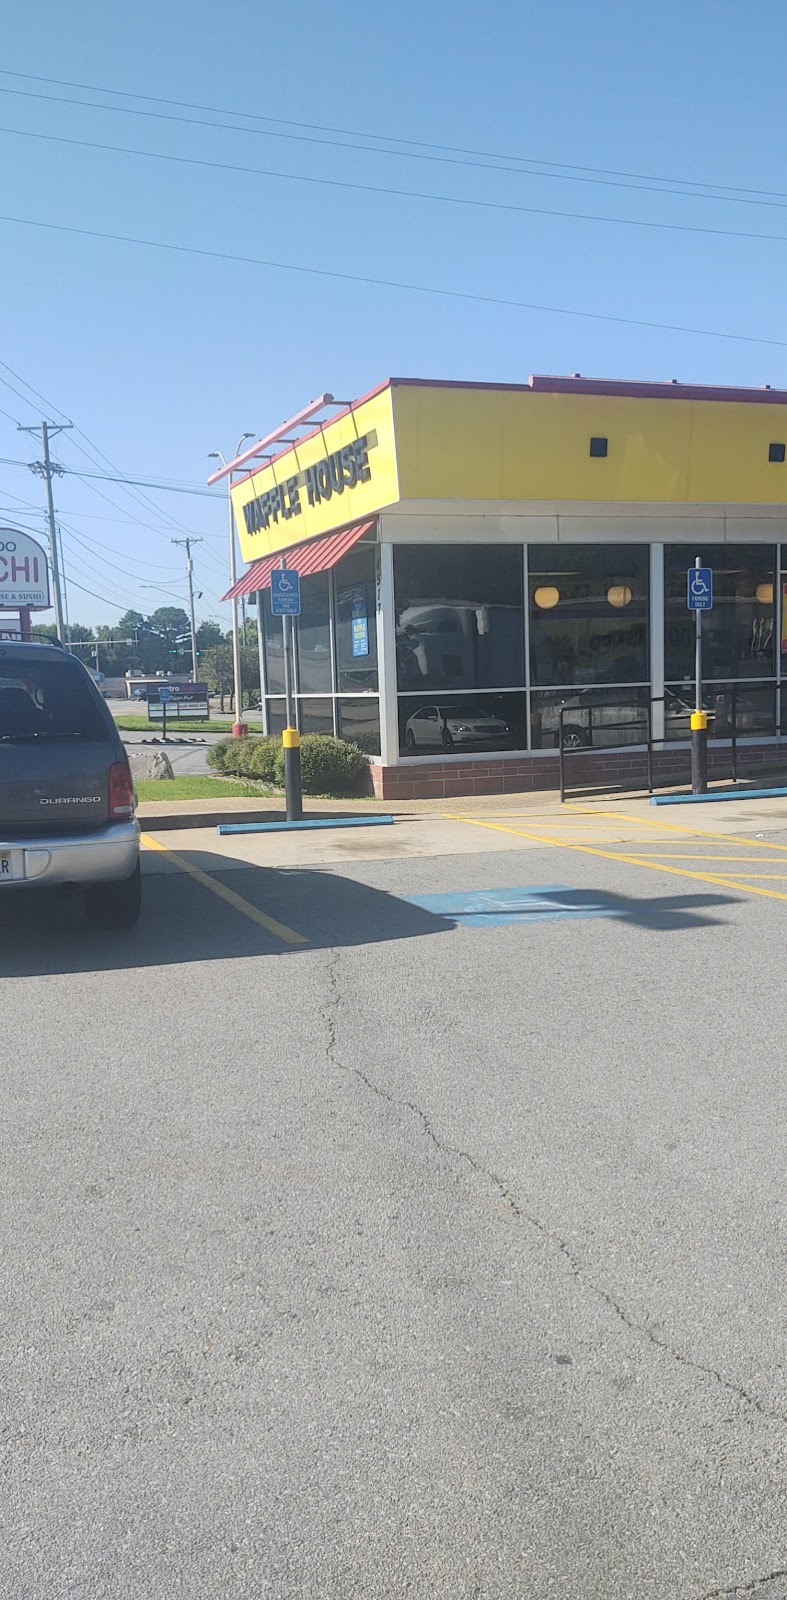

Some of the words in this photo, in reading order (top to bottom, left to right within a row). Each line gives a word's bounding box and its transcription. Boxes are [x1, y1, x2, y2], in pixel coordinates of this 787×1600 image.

[242, 476, 302, 536] WAFFLE
[304, 435, 371, 508] HOUSE
[40, 796, 102, 805] DURANGO
[0, 860, 9, 874] R
